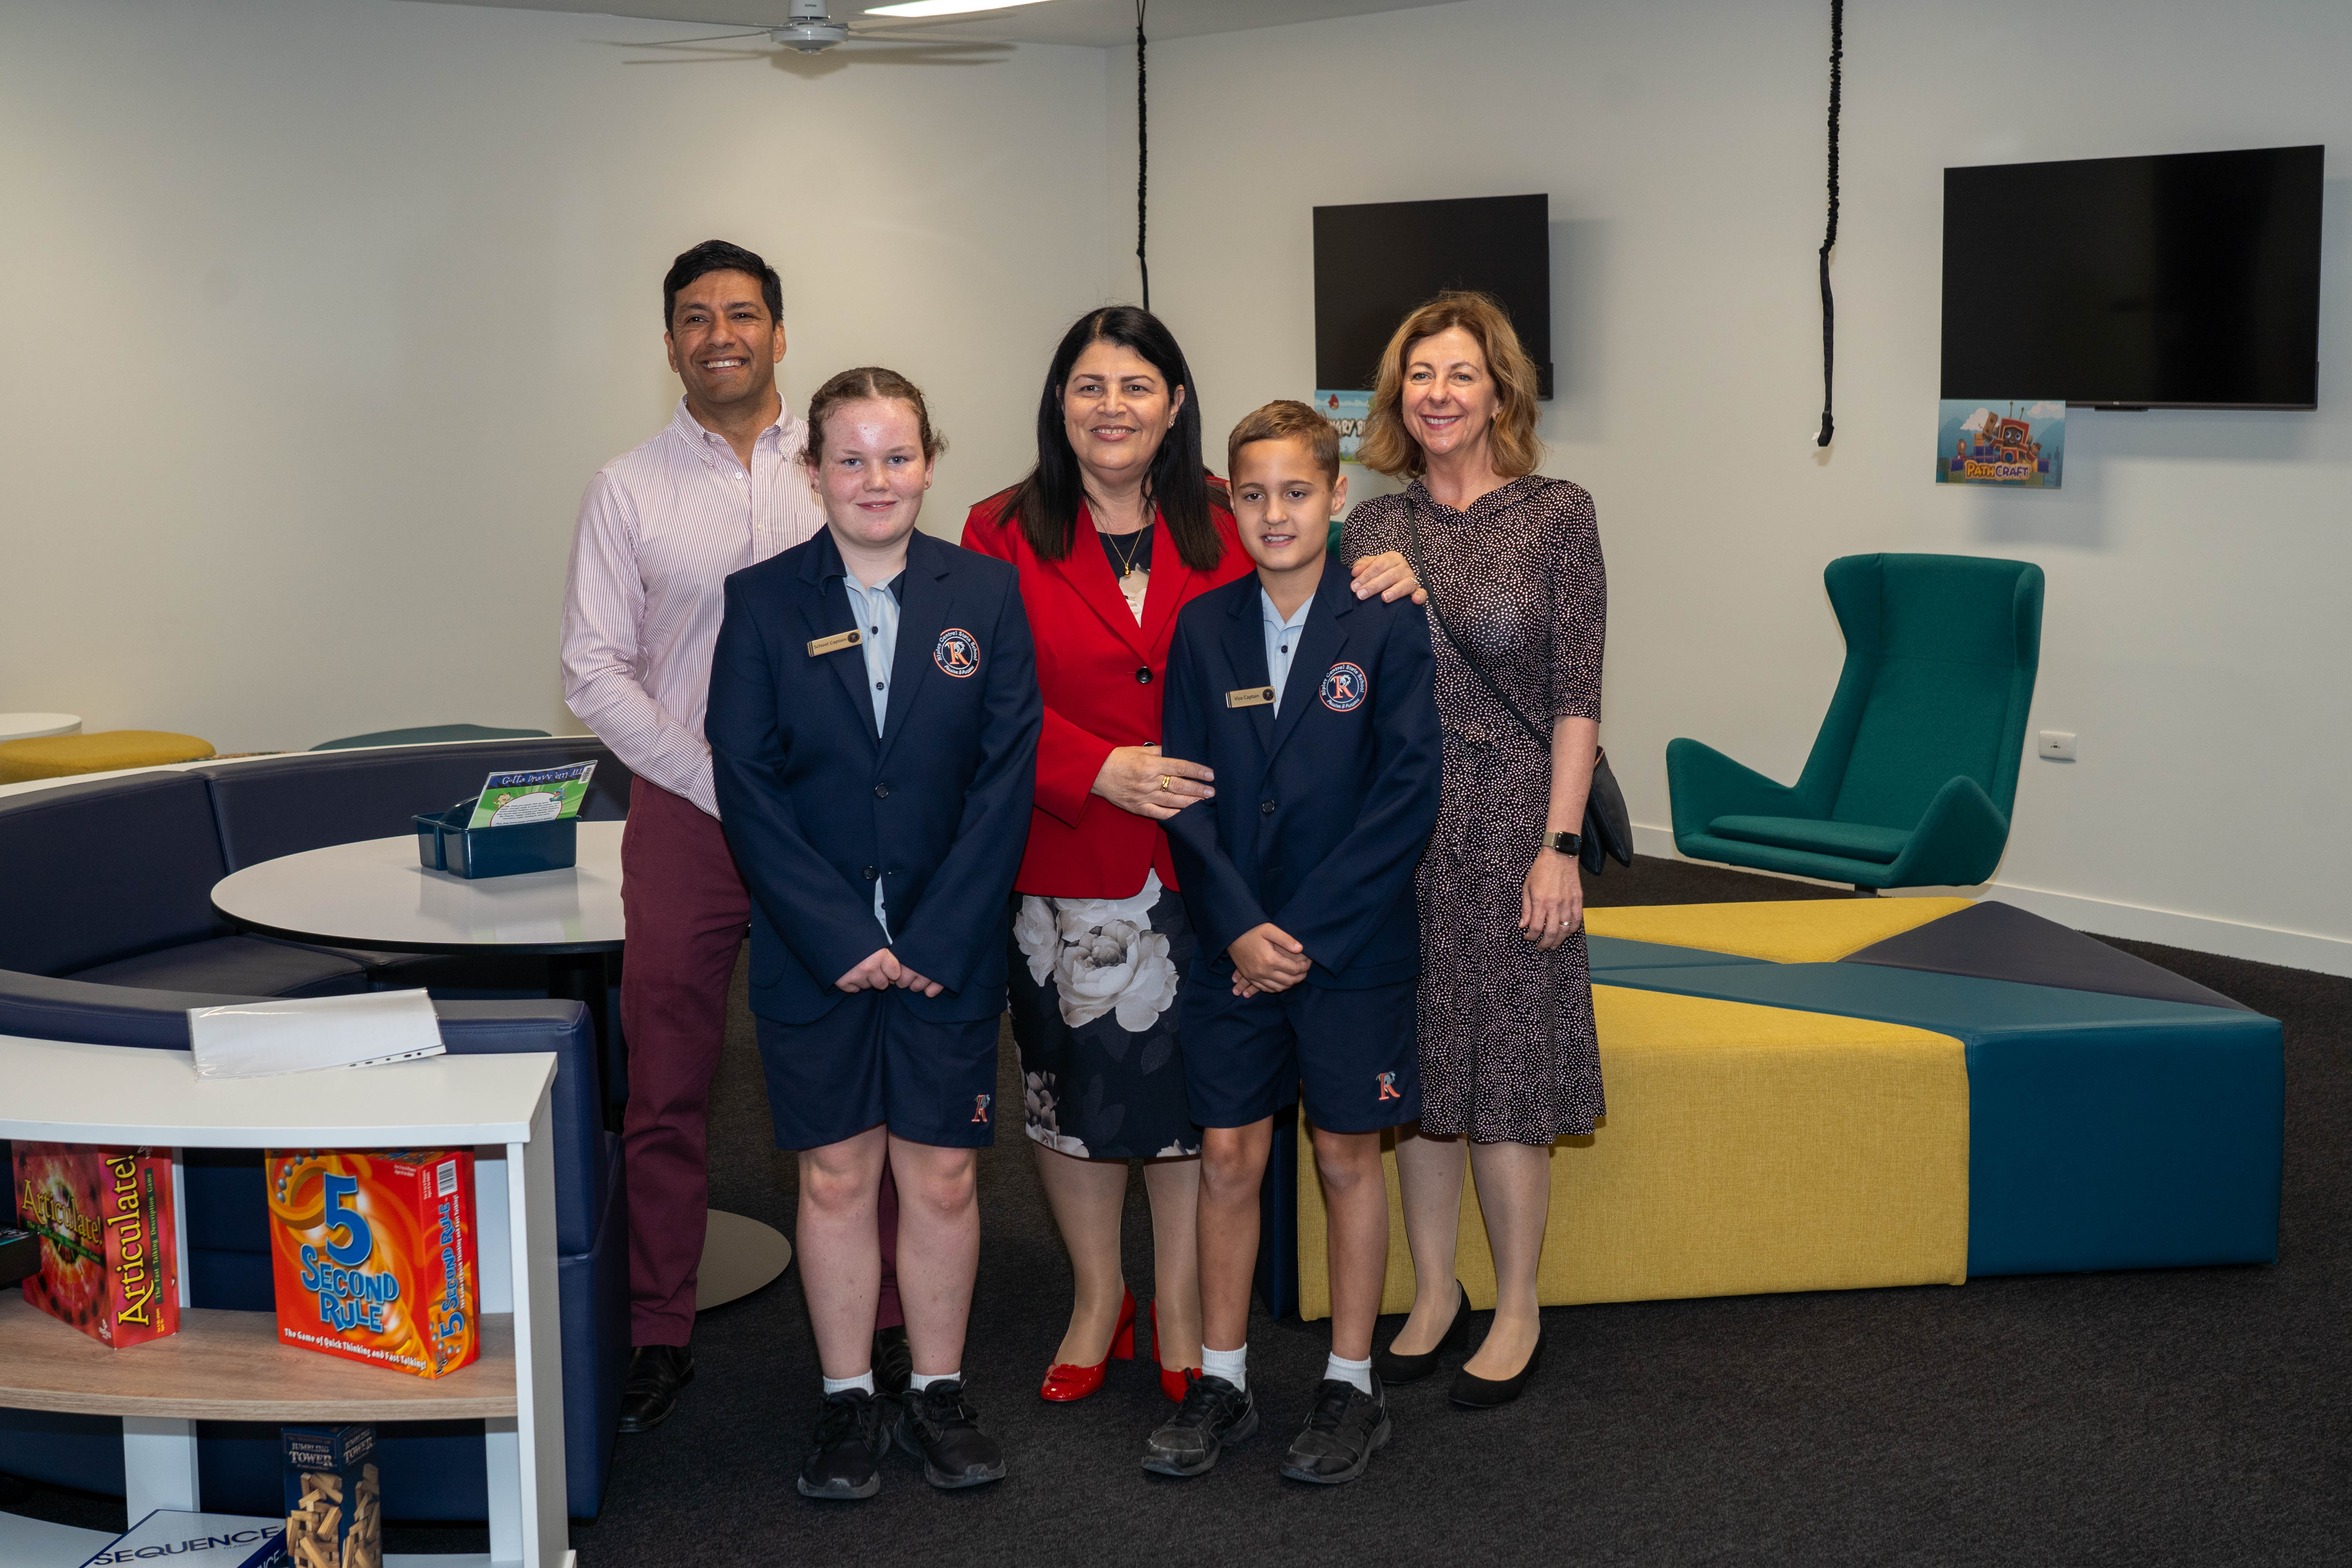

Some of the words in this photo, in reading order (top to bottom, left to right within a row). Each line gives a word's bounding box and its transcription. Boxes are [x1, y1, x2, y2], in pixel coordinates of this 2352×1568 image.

[939, 630, 957, 642] Central
[958, 631, 971, 642] State
[1326, 664, 1345, 677] Central
[1346, 665, 1358, 674] State
[502, 774, 525, 785] Gotta
[528, 773, 553, 782] Draw
[22, 1179, 103, 1245] Articulate!
[323, 1171, 372, 1266] 5
[438, 1202, 456, 1246] RULE
[105, 1155, 154, 1325] Articulate!
[300, 1243, 400, 1304] SECOND
[441, 1247, 459, 1312] SECOND
[319, 1289, 383, 1332] RULE
[439, 1311, 465, 1339] 5
[284, 1328, 296, 1338] The
[297, 1331, 315, 1343] Game
[316, 1337, 324, 1346] of
[324, 1337, 342, 1349] Quick
[343, 1341, 371, 1358] Thinking
[372, 1350, 384, 1359] and
[385, 1351, 400, 1363] Fast
[400, 1355, 427, 1371] Talking!
[289, 1451, 334, 1467] TOWER
[94, 1526, 279, 1565] SEQUENCE
